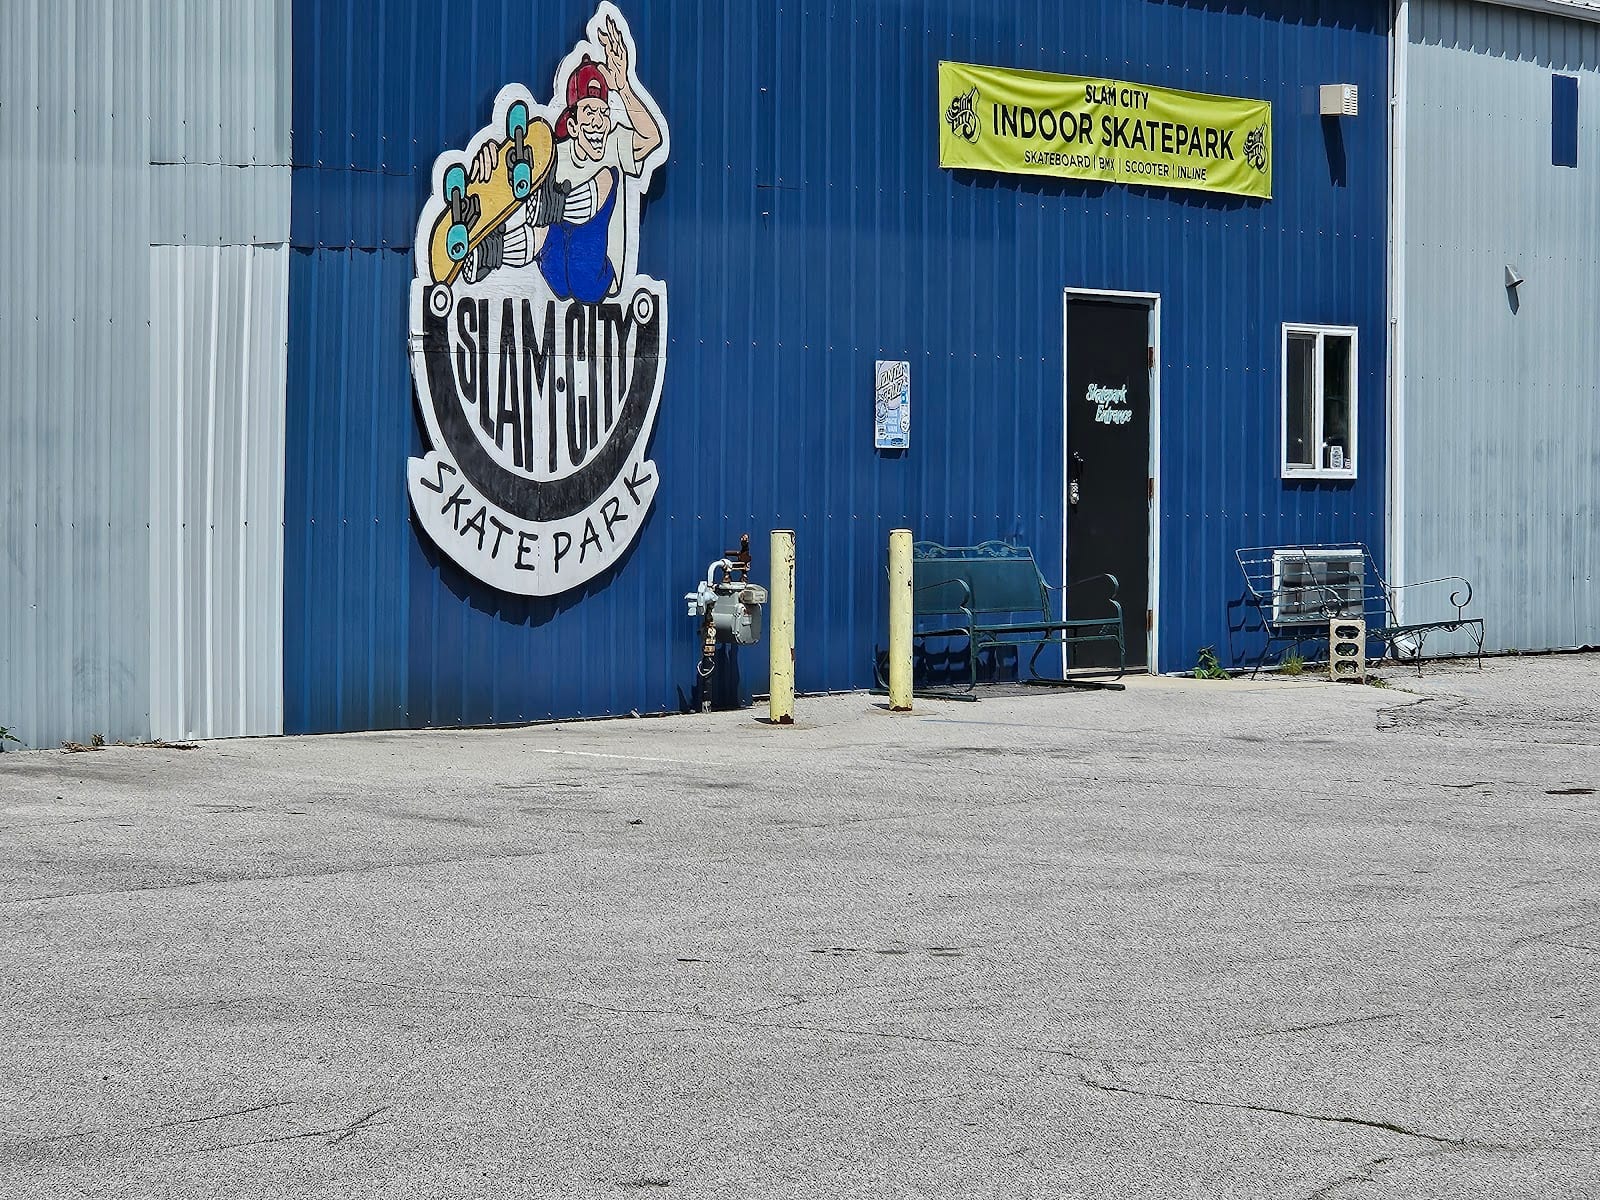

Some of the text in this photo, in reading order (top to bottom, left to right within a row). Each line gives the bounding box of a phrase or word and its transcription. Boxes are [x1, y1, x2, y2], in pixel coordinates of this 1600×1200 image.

[1085, 84, 1149, 110] SLAM CITY
[992, 103, 1235, 160] INDOOR SKATEPARK
[1024, 150, 1207, 181] SKATEBOARD BMX SCOOTER INLINE
[456, 297, 635, 473] SLAM CITY
